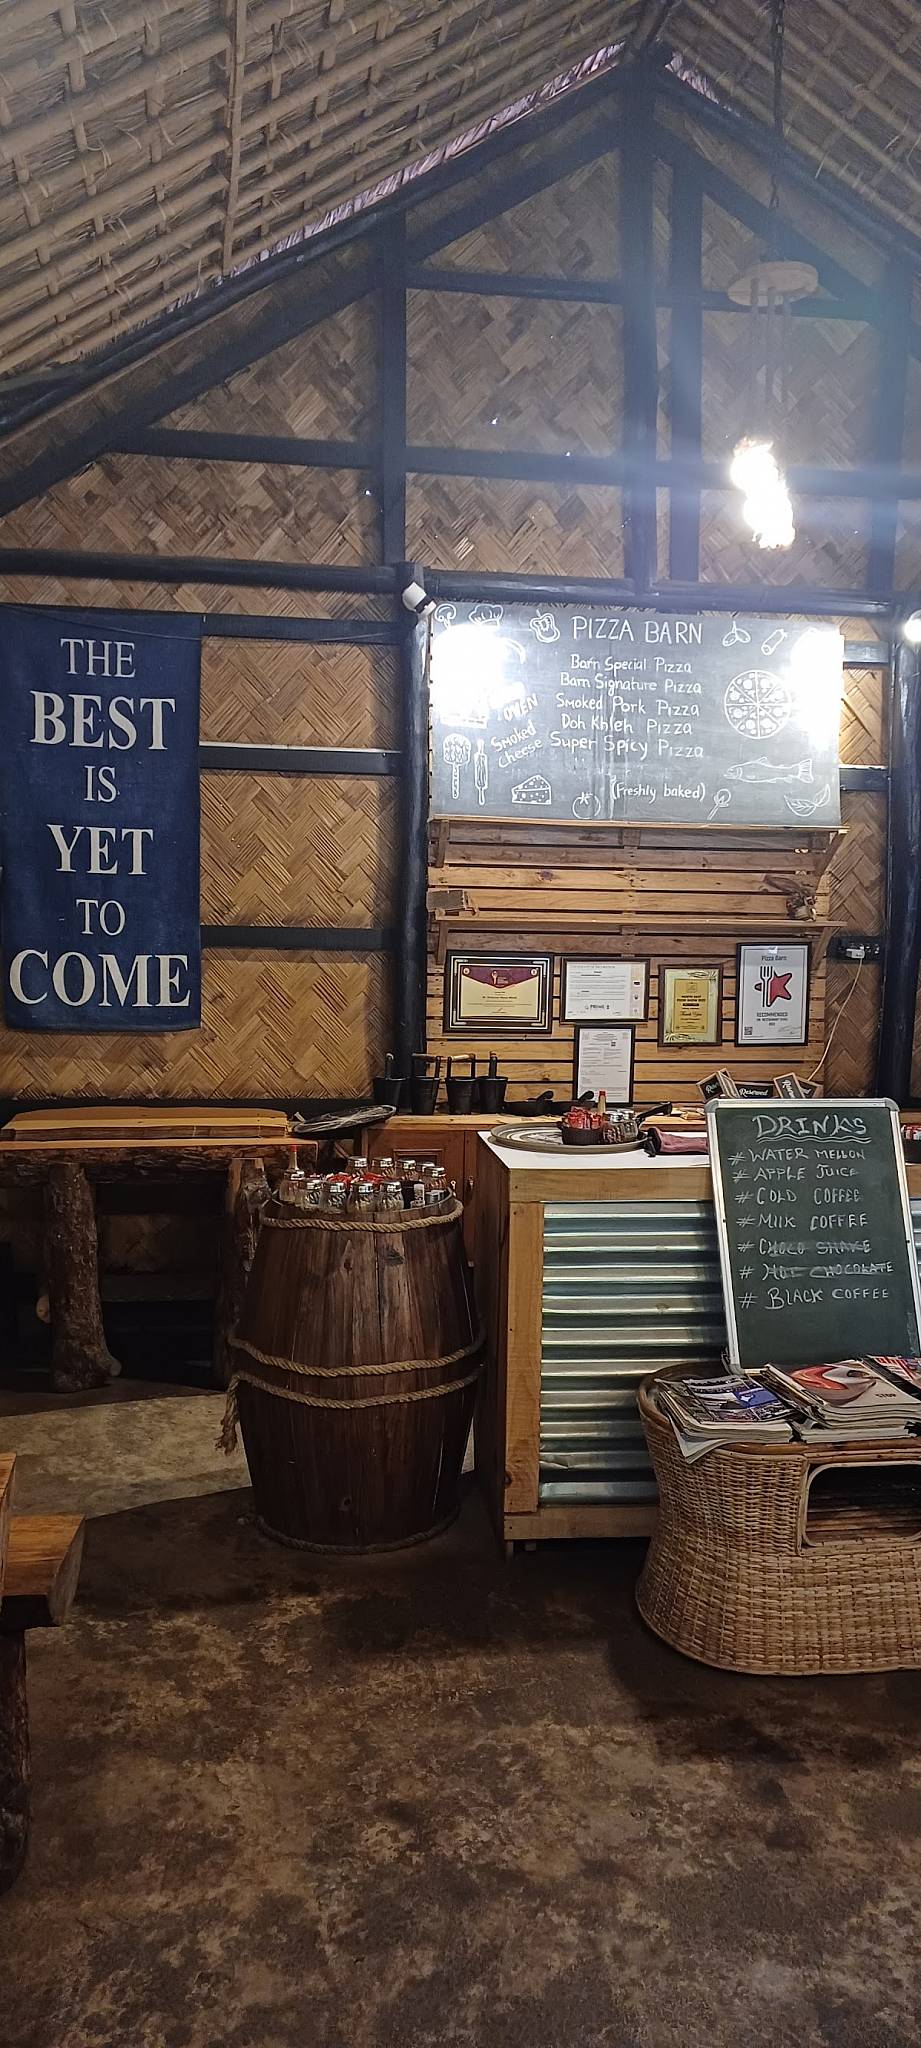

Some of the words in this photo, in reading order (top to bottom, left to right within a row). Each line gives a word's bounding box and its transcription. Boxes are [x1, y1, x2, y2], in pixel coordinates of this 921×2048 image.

[571, 615, 634, 642] PIZZA
[645, 620, 702, 644] BARN
[60, 638, 136, 678] THE
[571, 653, 600, 670] Barn
[604, 656, 647, 678] Special
[654, 656, 693, 674] Pizza
[560, 671, 591, 688] Barn
[595, 673, 658, 697] Signature
[664, 678, 702, 694] Pizza
[503, 692, 539, 721] OVEN
[556, 692, 603, 710] Smoked
[612, 695, 646, 714] Pork
[656, 699, 700, 717] Pizza
[30, 690, 176, 751] BEST
[561, 713, 586, 730] Doh
[647, 718, 693, 735] Pizza
[490, 718, 537, 752] Smoked
[550, 730, 596, 754] Super
[604, 735, 648, 761] Spicy
[658, 738, 704, 758] Pizza
[84, 766, 117, 802] IS
[611, 781, 657, 804] (Freshly
[663, 782, 706, 803] baked)
[47, 823, 154, 876] YET
[76, 898, 126, 936] TO
[9, 949, 191, 1008] COME
[752, 1114, 867, 1137] DRINKS
[748, 1148, 809, 1162] WATER
[754, 1166, 806, 1181] APPLE
[816, 1164, 859, 1179] JUICE
[756, 1187, 797, 1205] COLD
[814, 1188, 862, 1205] COFFEE
[810, 1213, 868, 1231] COFFEE
[765, 1287, 824, 1310] BLACK
[831, 1288, 889, 1300] COFFEE
